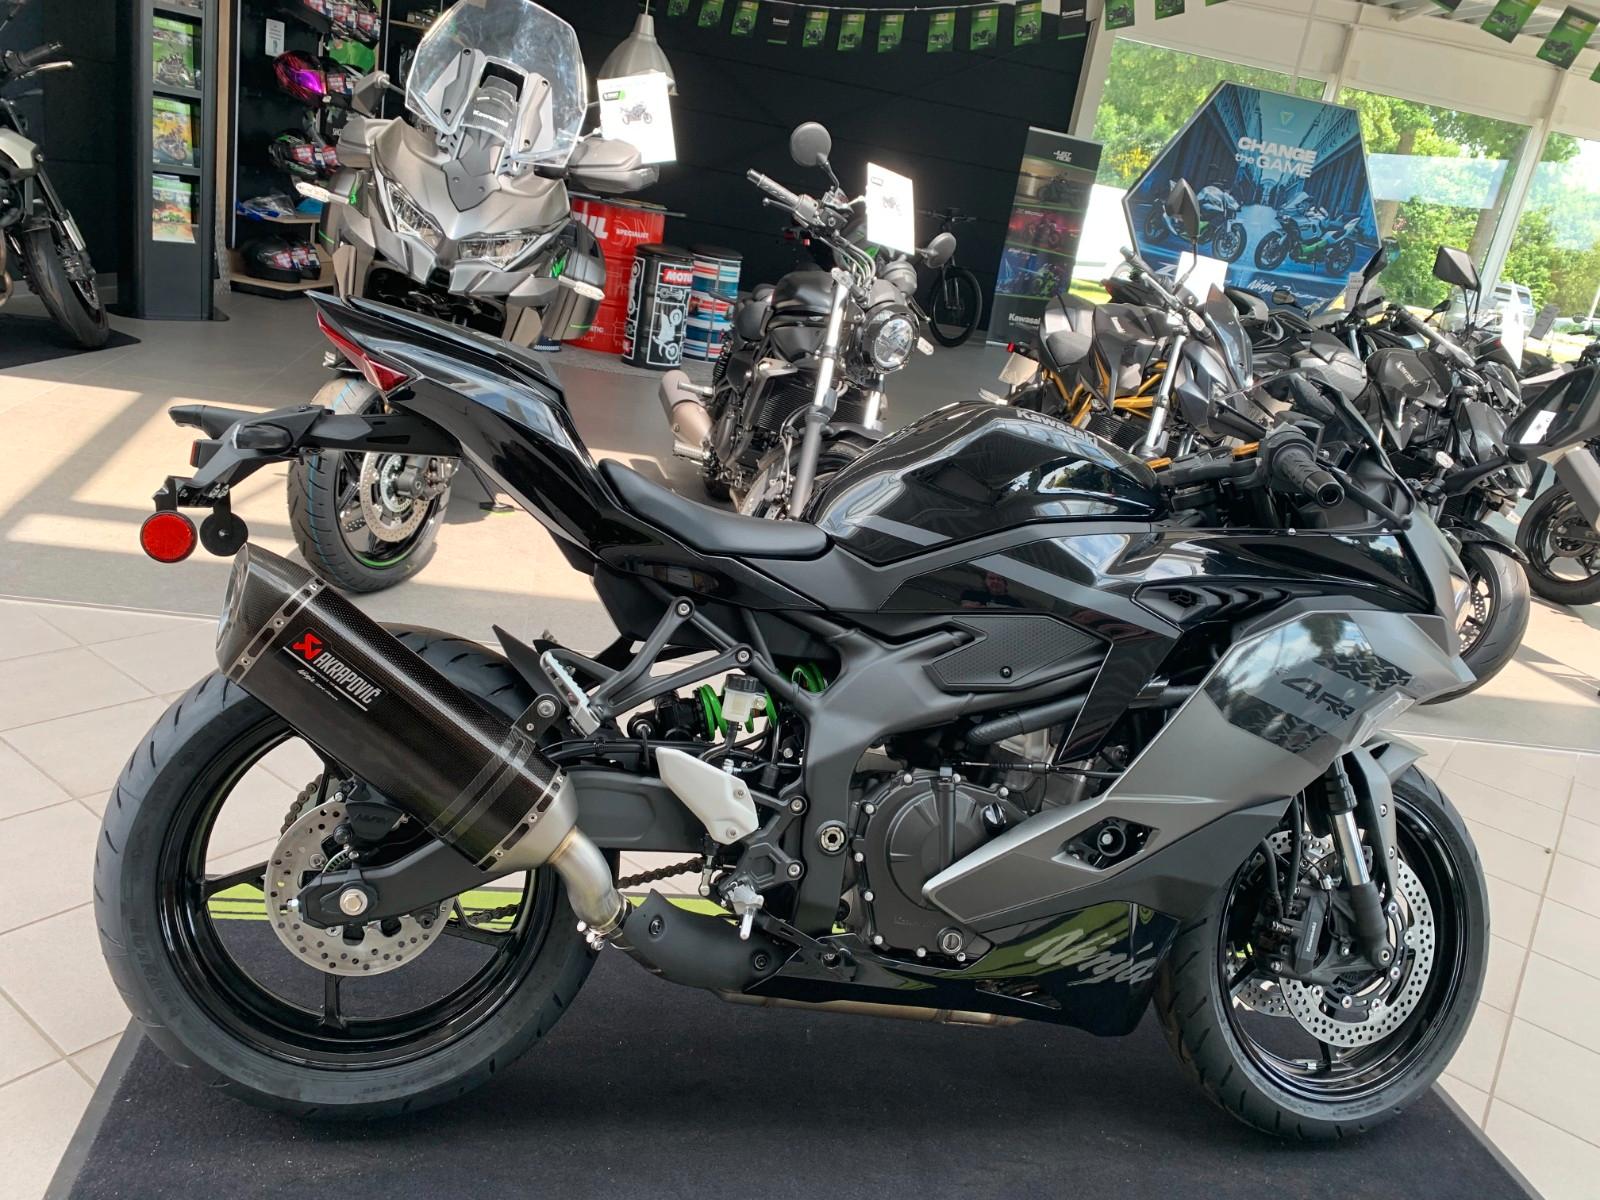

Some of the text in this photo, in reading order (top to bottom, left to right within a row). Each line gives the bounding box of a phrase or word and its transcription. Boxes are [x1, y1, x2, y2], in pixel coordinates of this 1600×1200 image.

[473, 110, 509, 127] Kawasaki
[1238, 136, 1317, 162] CHANGE
[1235, 153, 1313, 178] the GAME
[616, 227, 649, 239] SPECIALIST
[1247, 279, 1278, 294] Ninja
[1016, 408, 1099, 448] Kawasaki
[1023, 928, 1158, 987] Ninja
